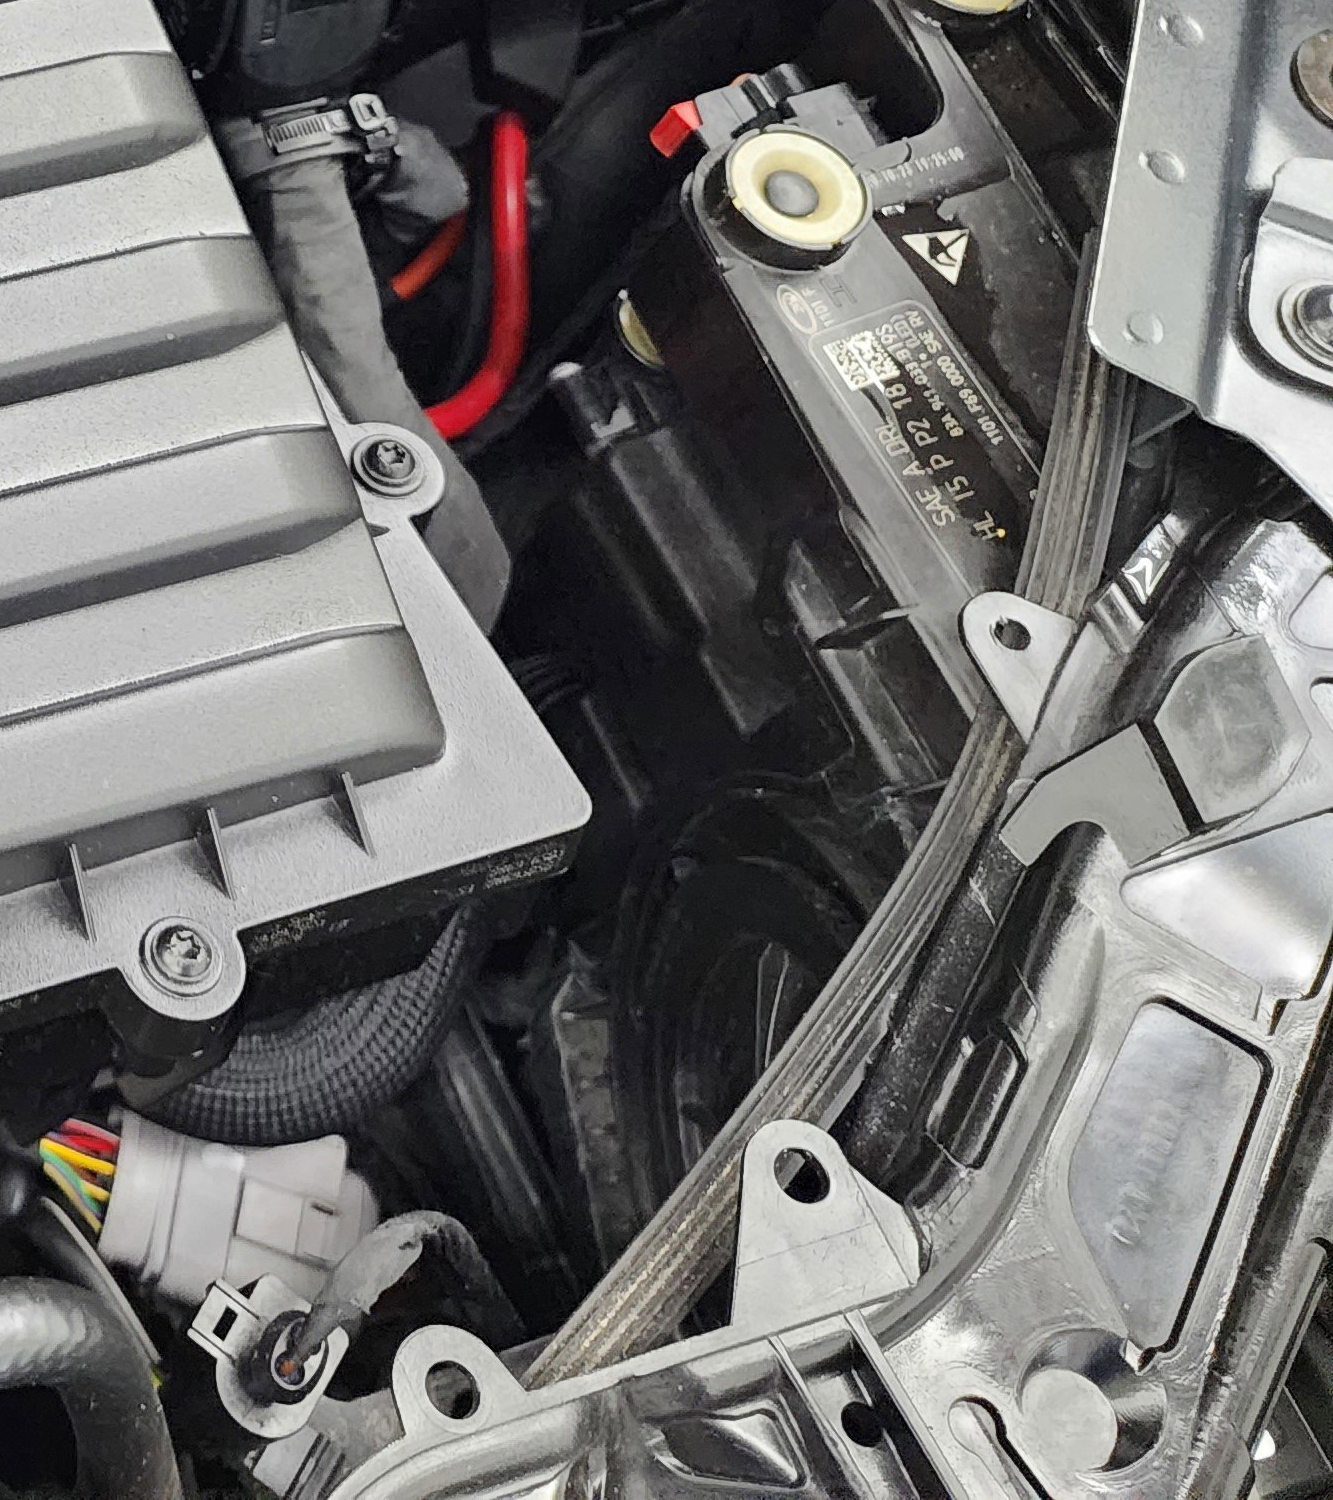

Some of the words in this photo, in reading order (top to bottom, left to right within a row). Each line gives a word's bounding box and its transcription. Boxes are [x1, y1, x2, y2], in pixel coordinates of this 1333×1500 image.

[881, 384, 911, 409] 18
[874, 417, 909, 461] DRL
[907, 418, 938, 447] P2
[899, 461, 925, 479] A
[930, 455, 953, 469] P
[915, 486, 955, 528] SAE
